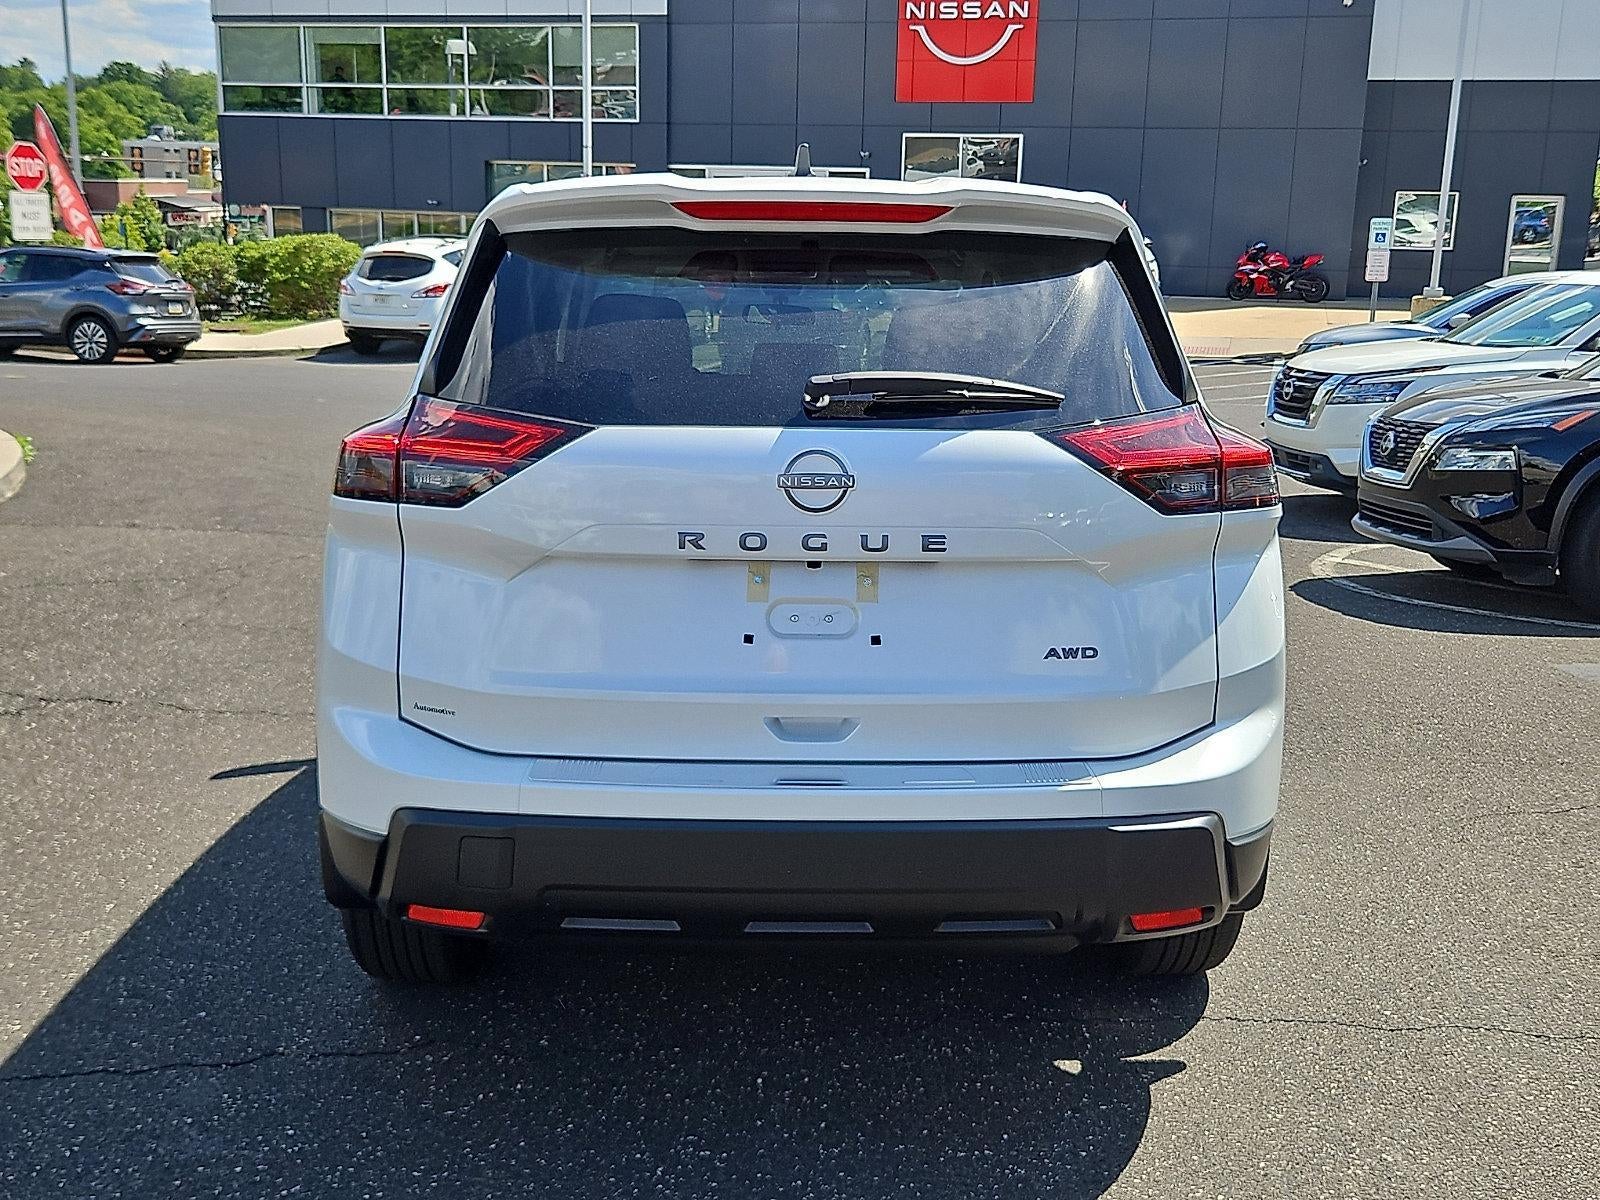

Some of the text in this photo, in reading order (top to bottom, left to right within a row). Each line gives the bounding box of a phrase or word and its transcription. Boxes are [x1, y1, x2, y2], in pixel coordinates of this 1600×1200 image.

[905, 1, 1029, 19] NISSAN
[10, 155, 44, 178] STOP
[779, 475, 854, 487] NISSAN
[677, 531, 948, 553] ROGUE
[1042, 646, 1099, 660] AWD
[413, 702, 456, 716] Automotive
